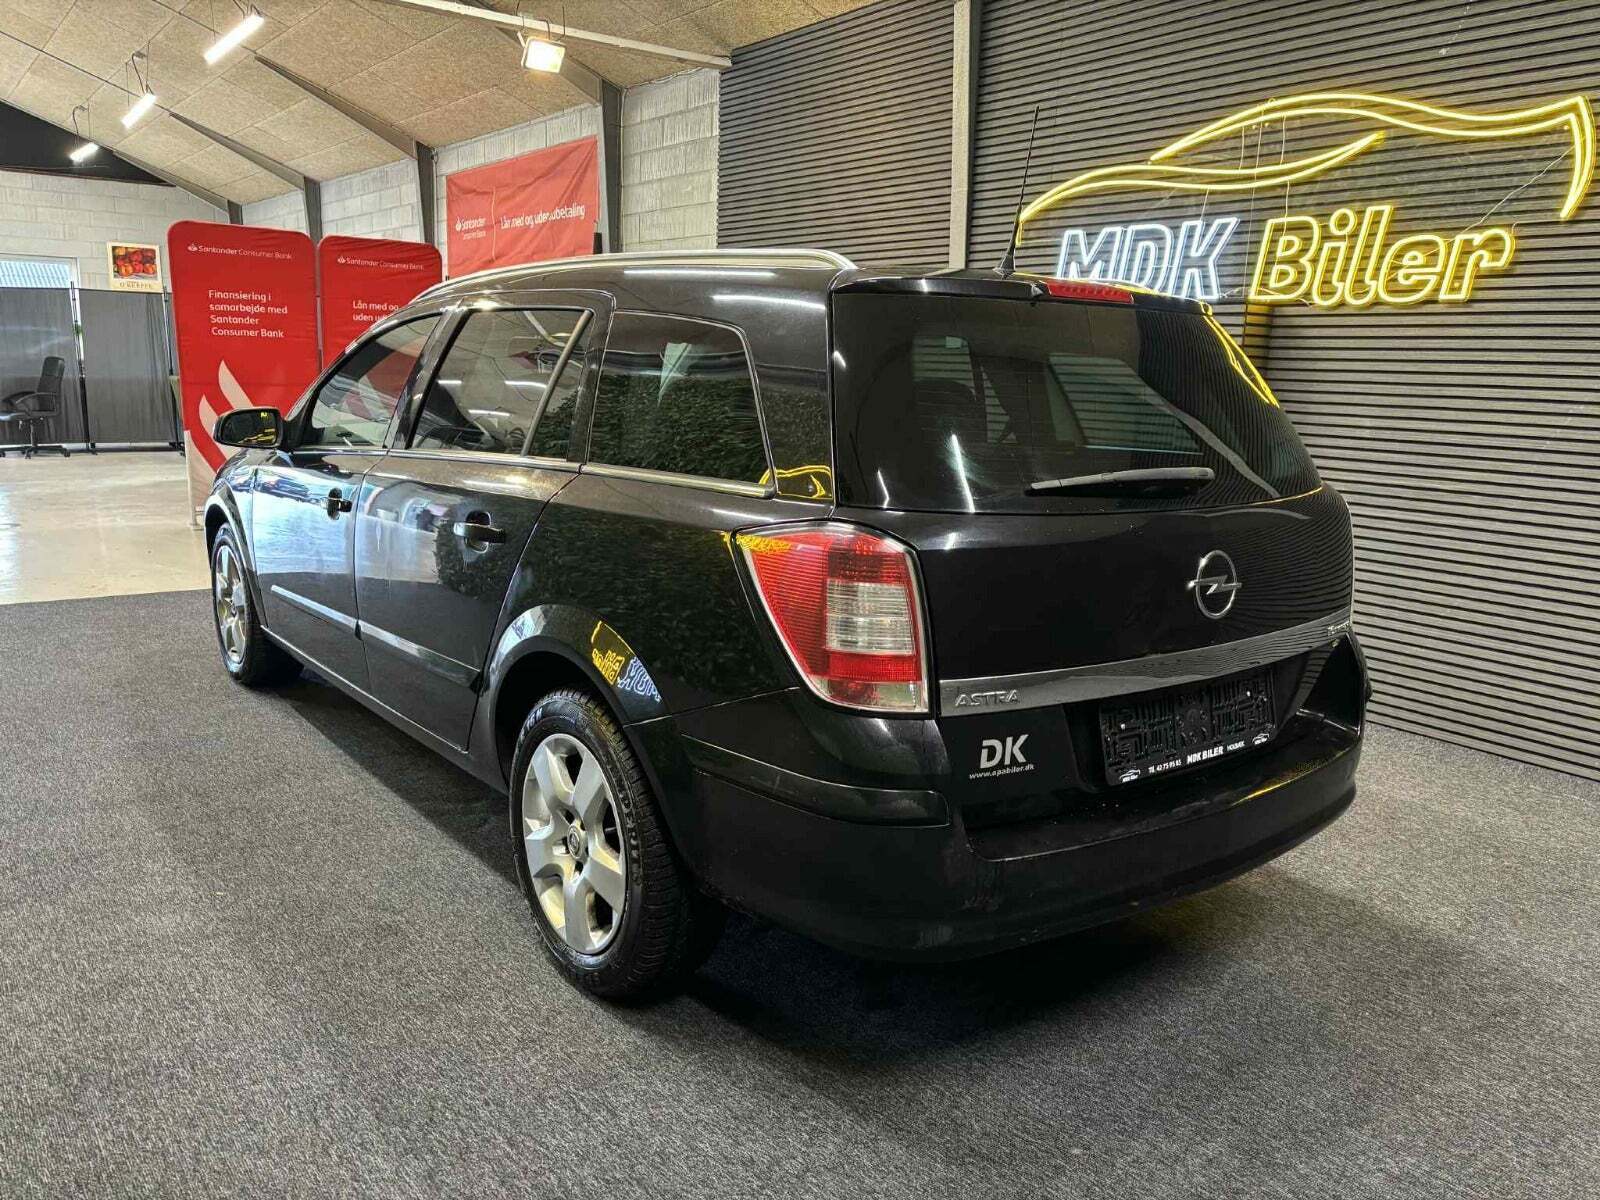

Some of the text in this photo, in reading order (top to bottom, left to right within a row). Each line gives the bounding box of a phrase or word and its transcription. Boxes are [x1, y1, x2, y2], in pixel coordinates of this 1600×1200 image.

[461, 217, 487, 230] Santander
[511, 213, 525, 227] med
[525, 214, 534, 228] og
[198, 245, 292, 260] Santander Consumer Bank
[1056, 205, 1514, 307] MDK Biler
[346, 256, 424, 270] Santander Consumer Bank
[208, 289, 266, 302] Finansiering
[209, 302, 288, 315] samarbejde med
[352, 300, 368, 309] Lån
[369, 301, 387, 311] med
[210, 314, 259, 325] Santander
[352, 312, 373, 322] uden
[211, 326, 284, 338] Consumer Bank
[955, 689, 1018, 707] ASTRA
[980, 733, 1029, 769] DK
[1186, 751, 1201, 764] MDK
[1202, 745, 1223, 760] BILER
[969, 763, 1035, 780] www.apabiler.dk
